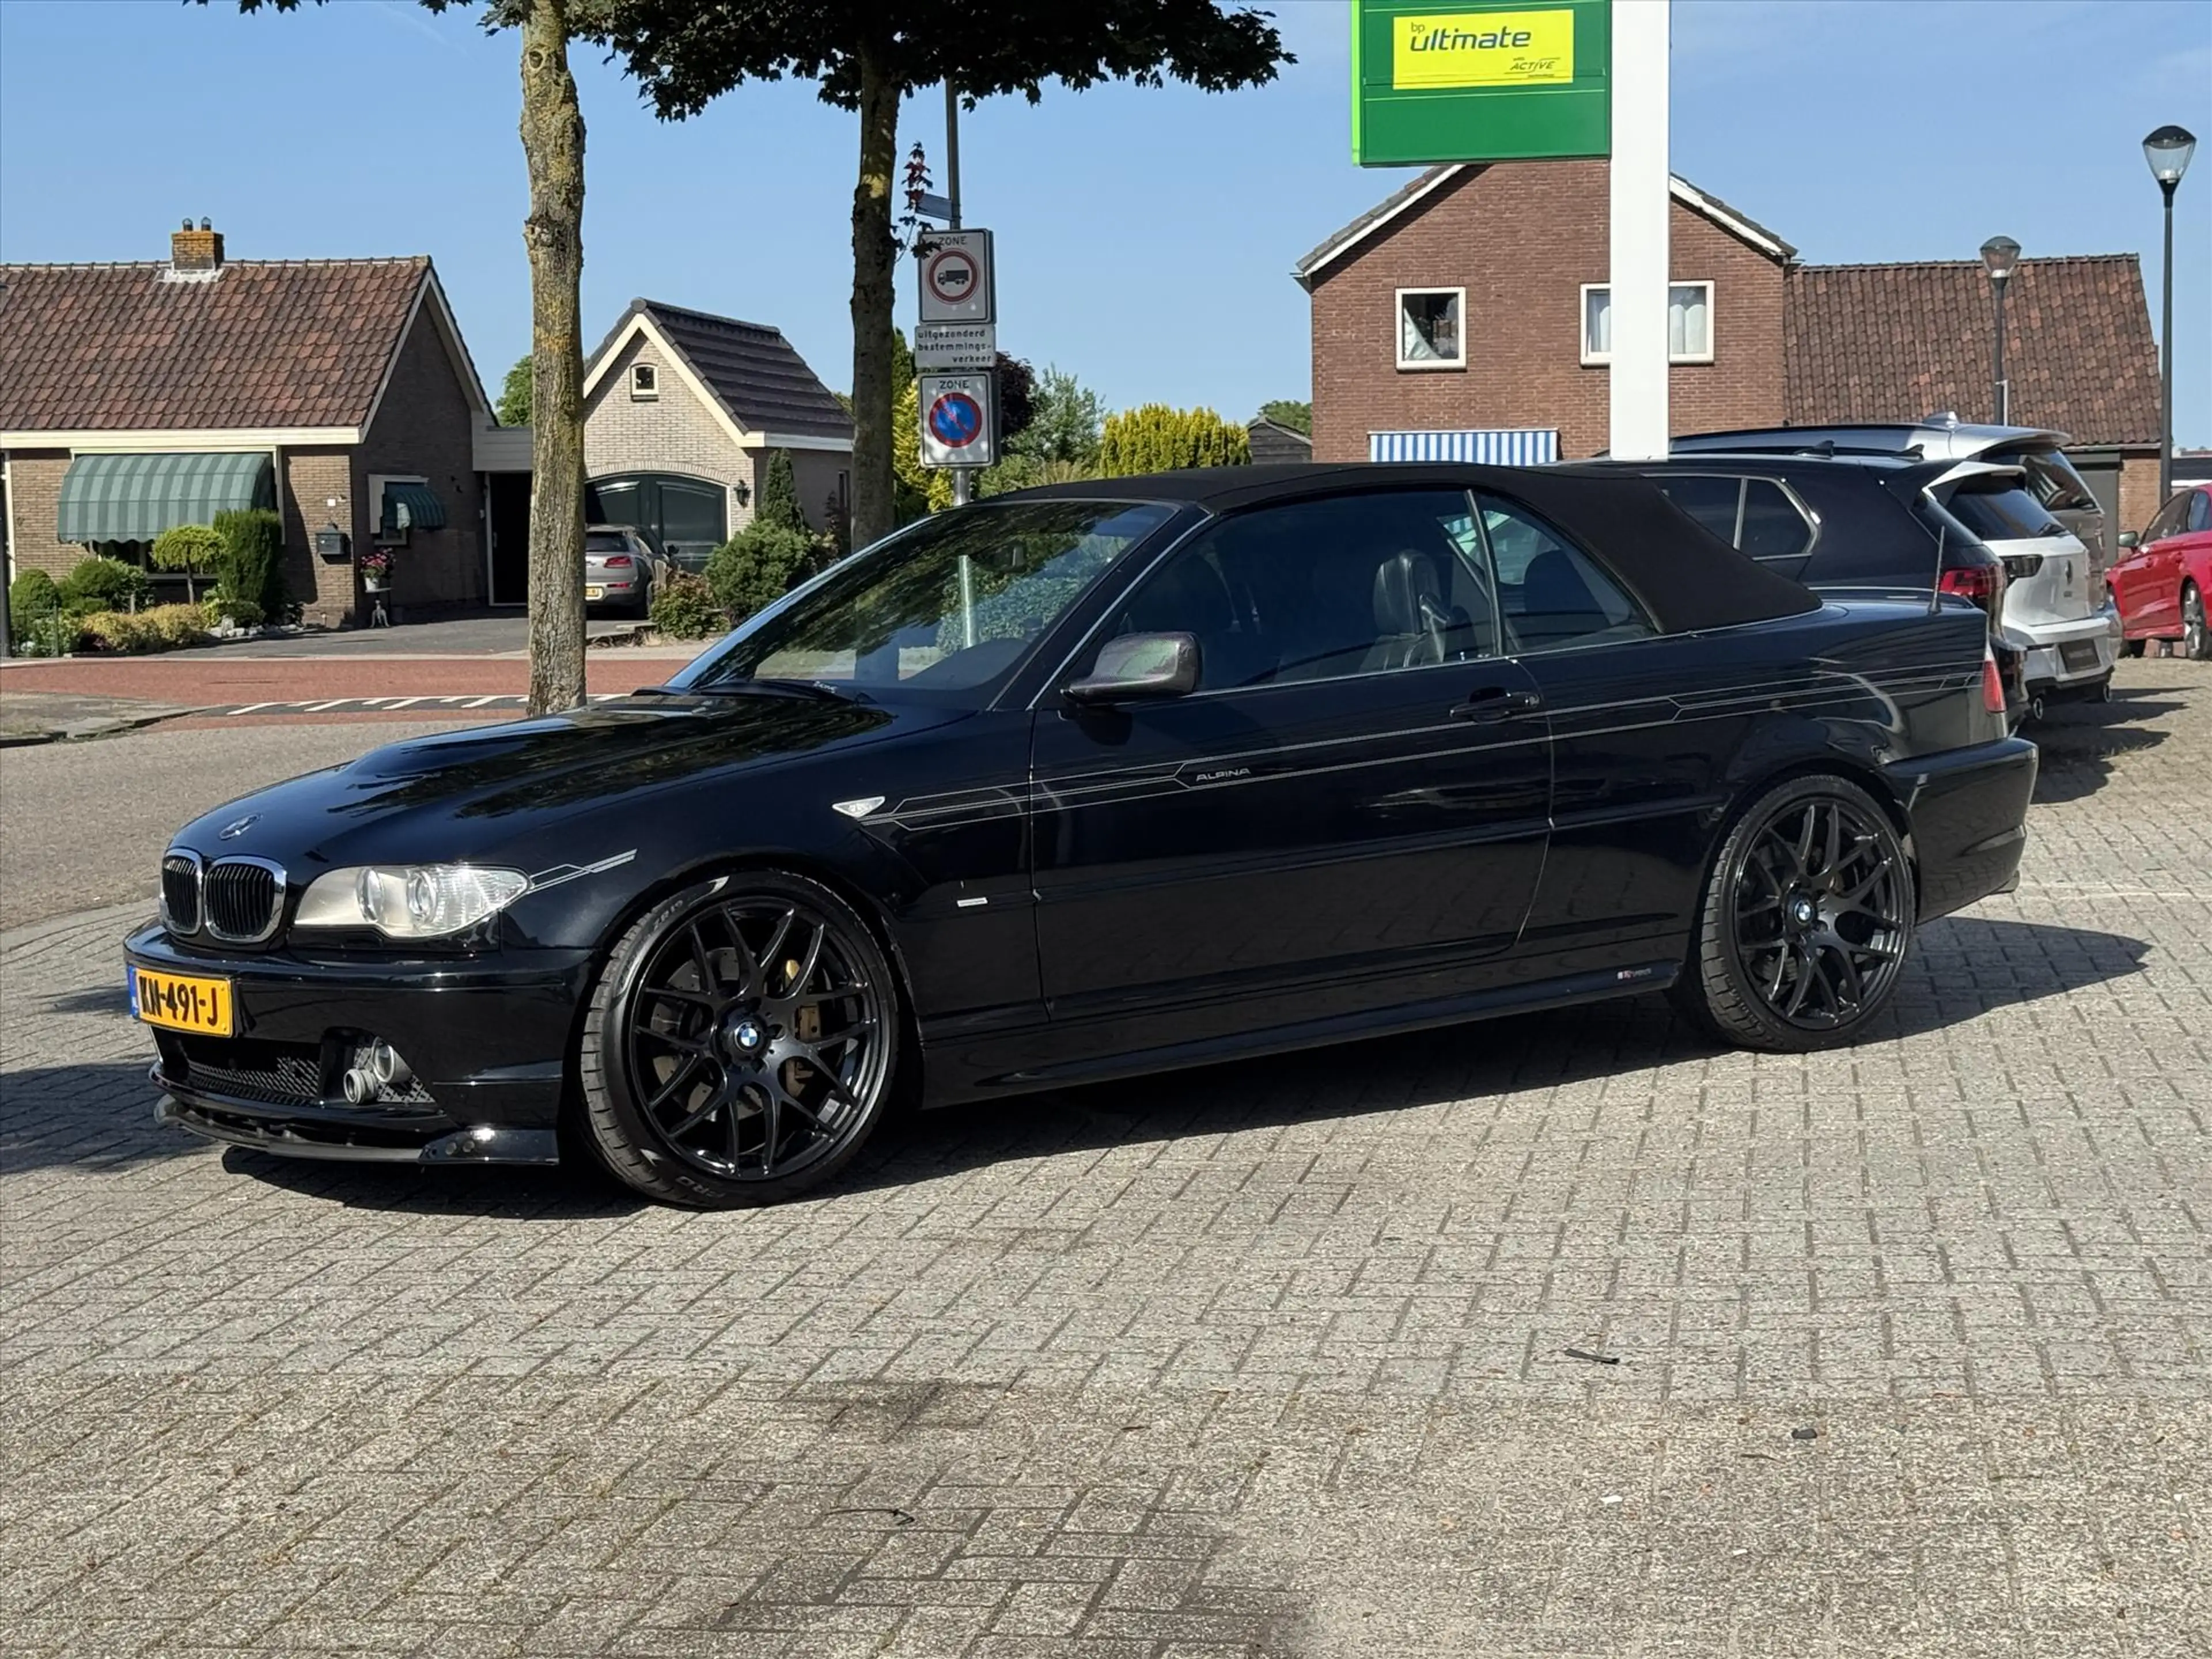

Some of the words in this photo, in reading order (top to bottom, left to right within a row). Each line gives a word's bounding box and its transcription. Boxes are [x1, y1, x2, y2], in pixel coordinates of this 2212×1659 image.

[1411, 22, 1425, 34] bp
[1410, 26, 1531, 51] ultimate
[1509, 61, 1556, 70] ACTIVE
[938, 236, 967, 245] ZONE
[918, 329, 986, 339] uitgezonderd
[940, 380, 969, 389] ZONE
[1196, 768, 1251, 782] ALPINA
[139, 976, 218, 1026] KN-491-J
